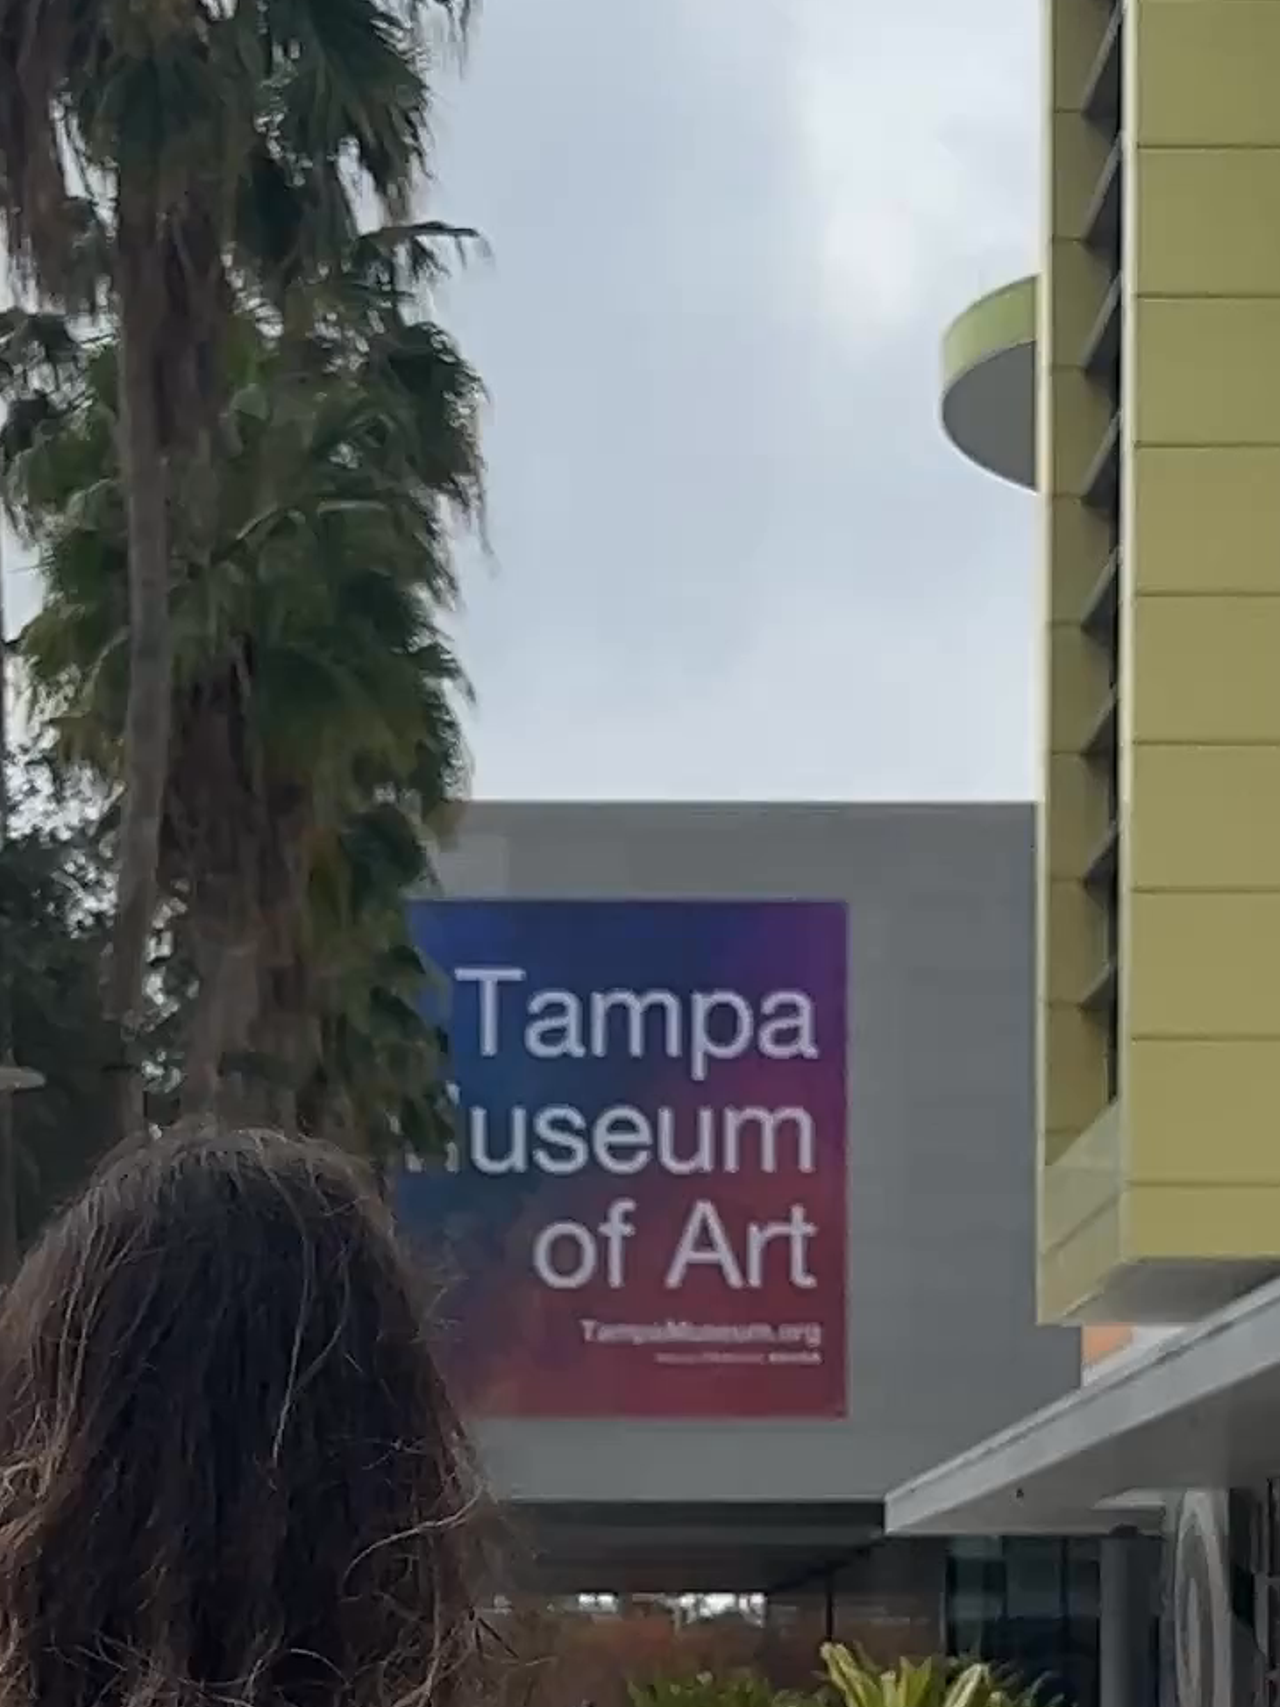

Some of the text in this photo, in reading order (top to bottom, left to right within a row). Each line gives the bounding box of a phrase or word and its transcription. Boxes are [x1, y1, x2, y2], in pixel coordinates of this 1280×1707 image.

[454, 966, 819, 1081] Tampa
[390, 1080, 814, 1175] useum
[533, 1199, 818, 1290] of Art
